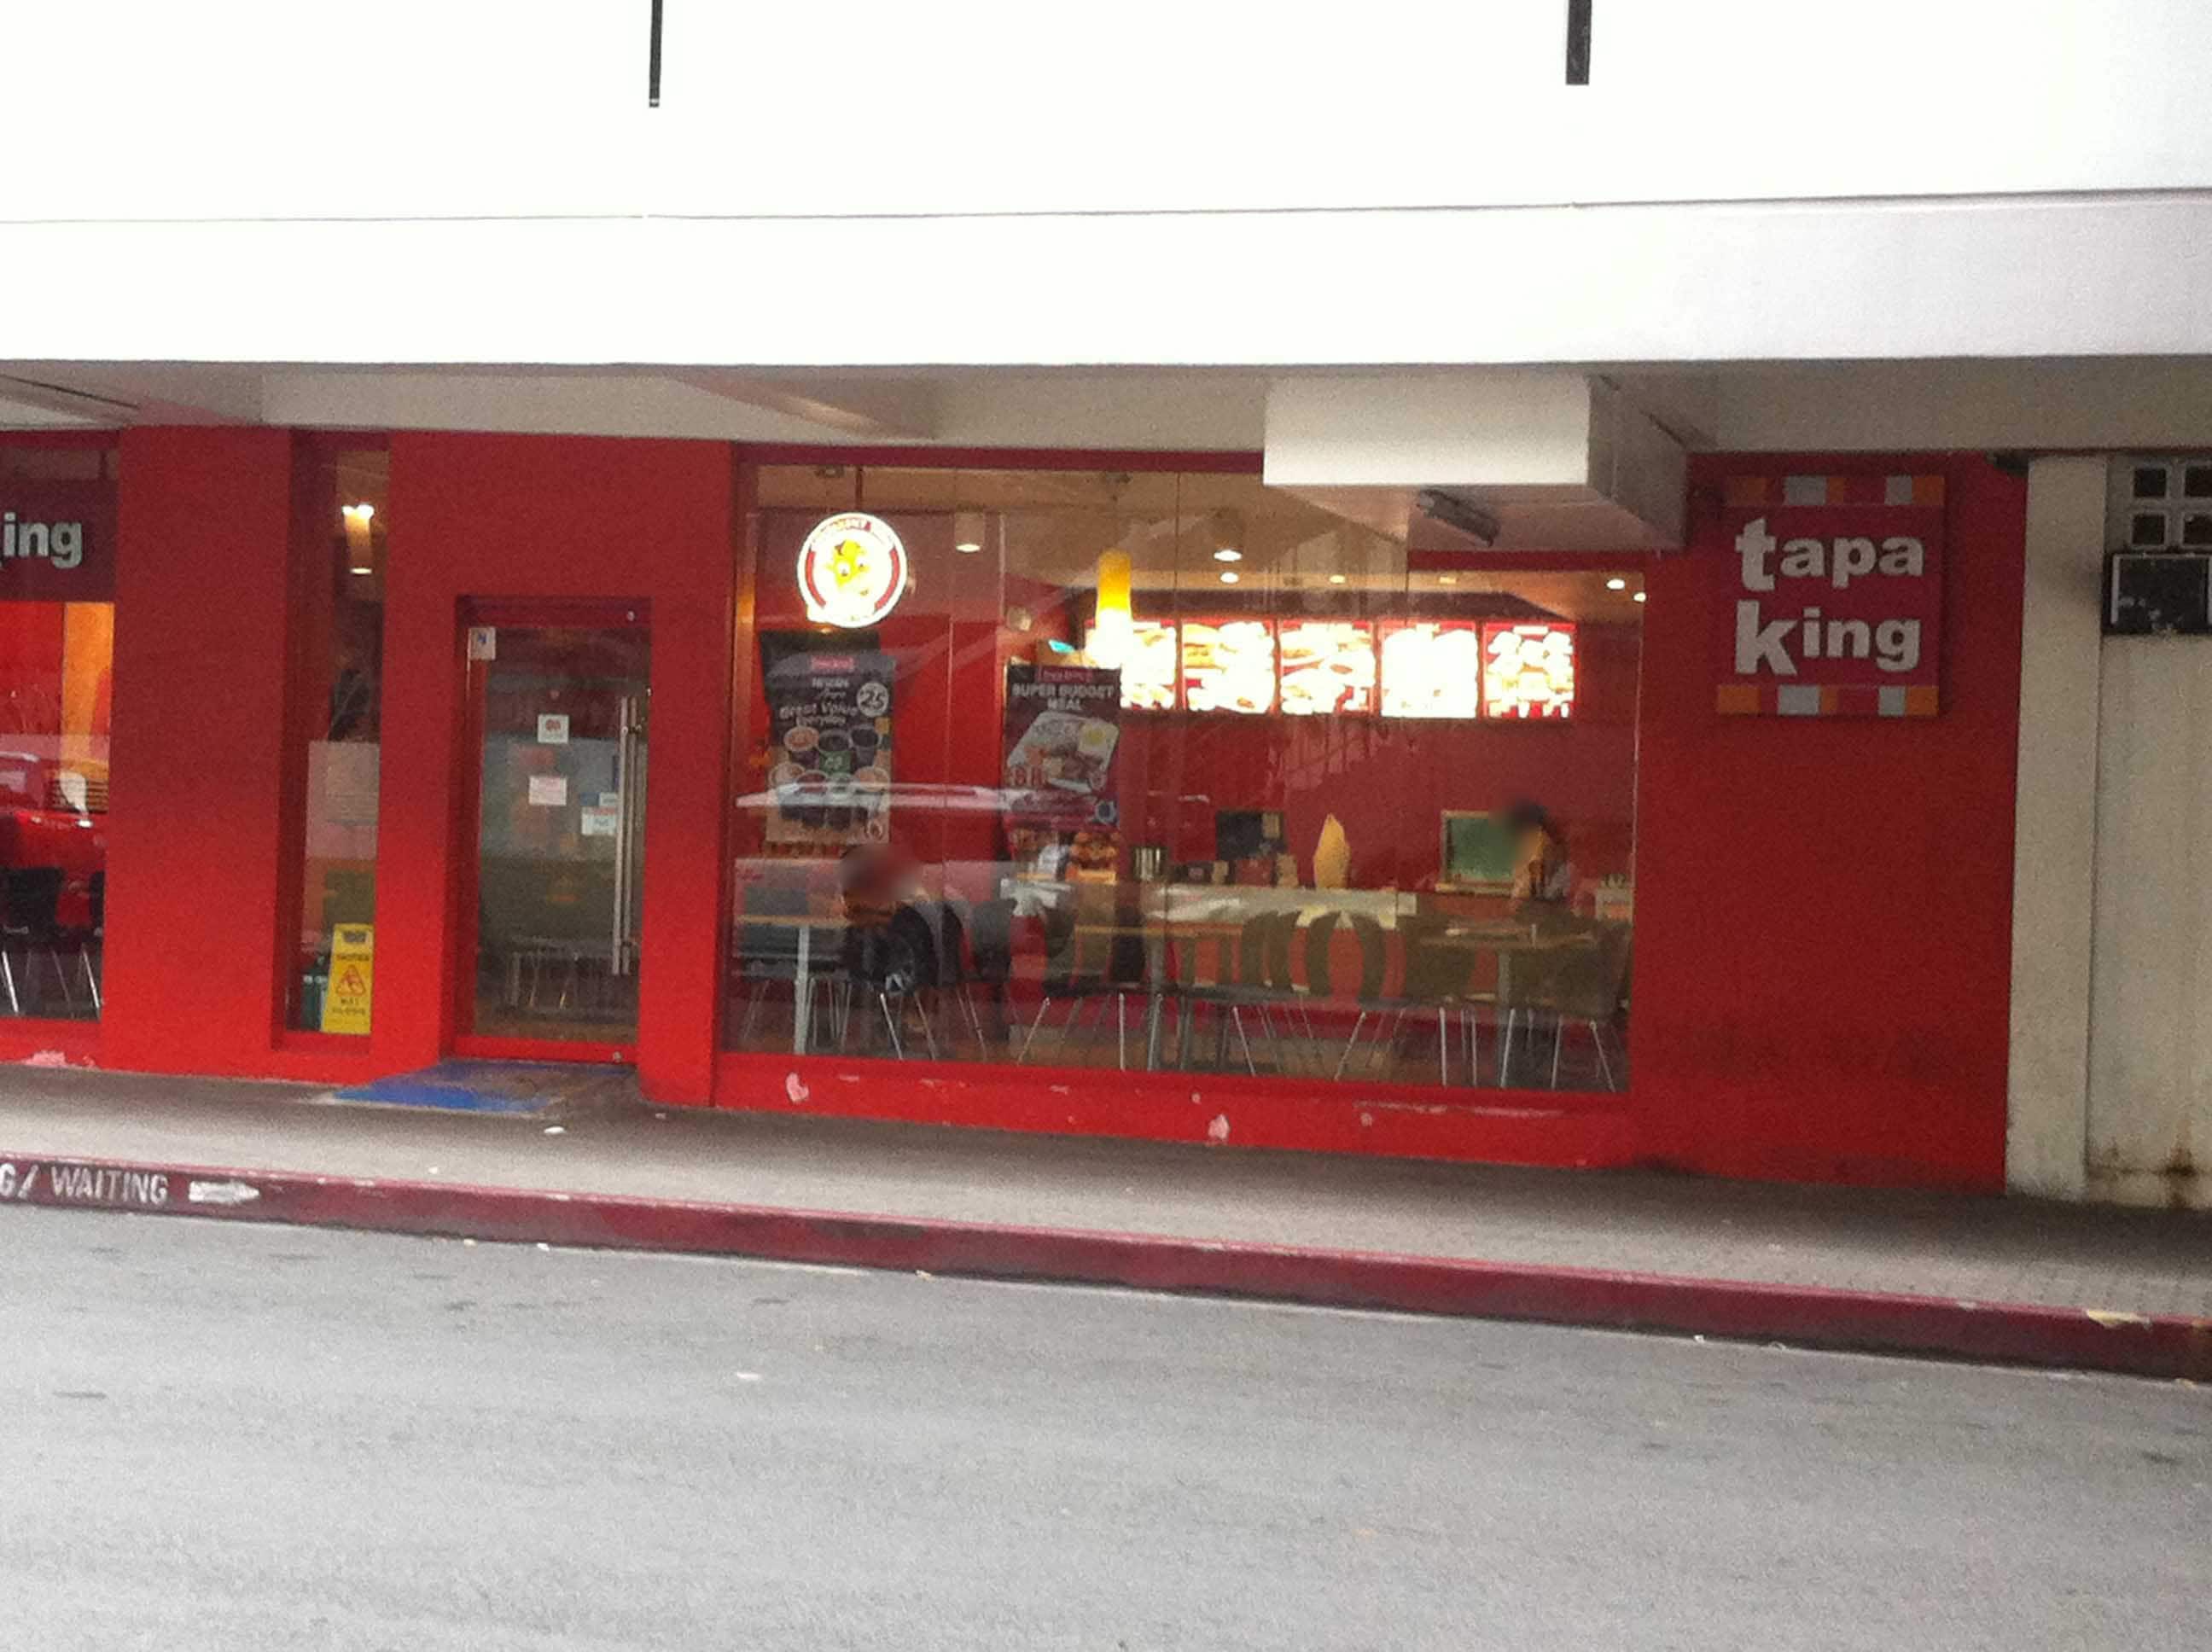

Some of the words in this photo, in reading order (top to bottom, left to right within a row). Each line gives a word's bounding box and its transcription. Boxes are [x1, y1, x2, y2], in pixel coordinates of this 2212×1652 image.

[0, 512, 83, 569] ing
[1735, 517, 1924, 591] tapa
[1735, 600, 1921, 675] king
[1011, 683, 1057, 696] SUPER
[51, 1166, 168, 1205] WAITING
